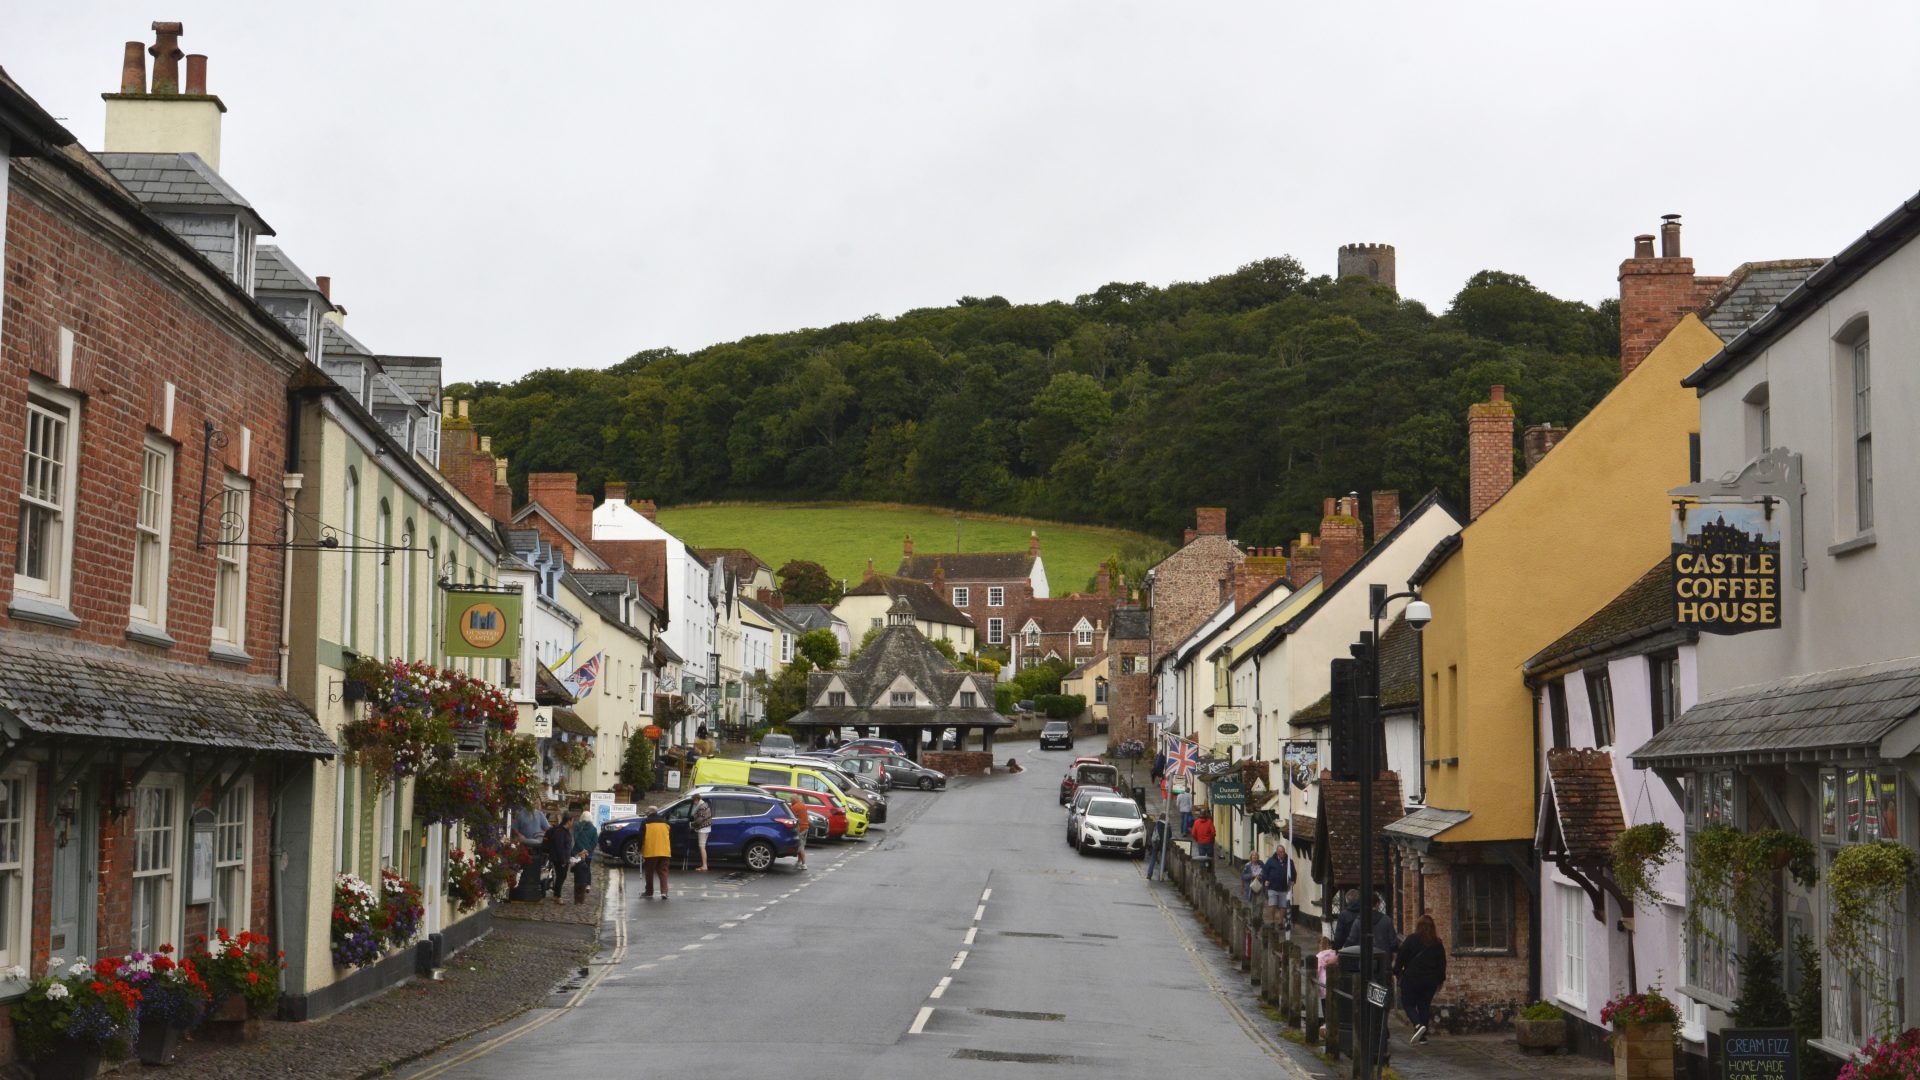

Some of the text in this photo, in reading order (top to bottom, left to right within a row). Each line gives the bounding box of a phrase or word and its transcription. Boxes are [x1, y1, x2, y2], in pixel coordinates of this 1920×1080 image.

[1676, 553, 1776, 574] CASTLE
[1676, 578, 1776, 598] COFFEE
[1677, 602, 1776, 623] HOUSE
[466, 629, 499, 637] DUNSTER
[1726, 1039, 1791, 1054] CREAM FIZZ
[1728, 1060, 1785, 1072] HOMEMADE
